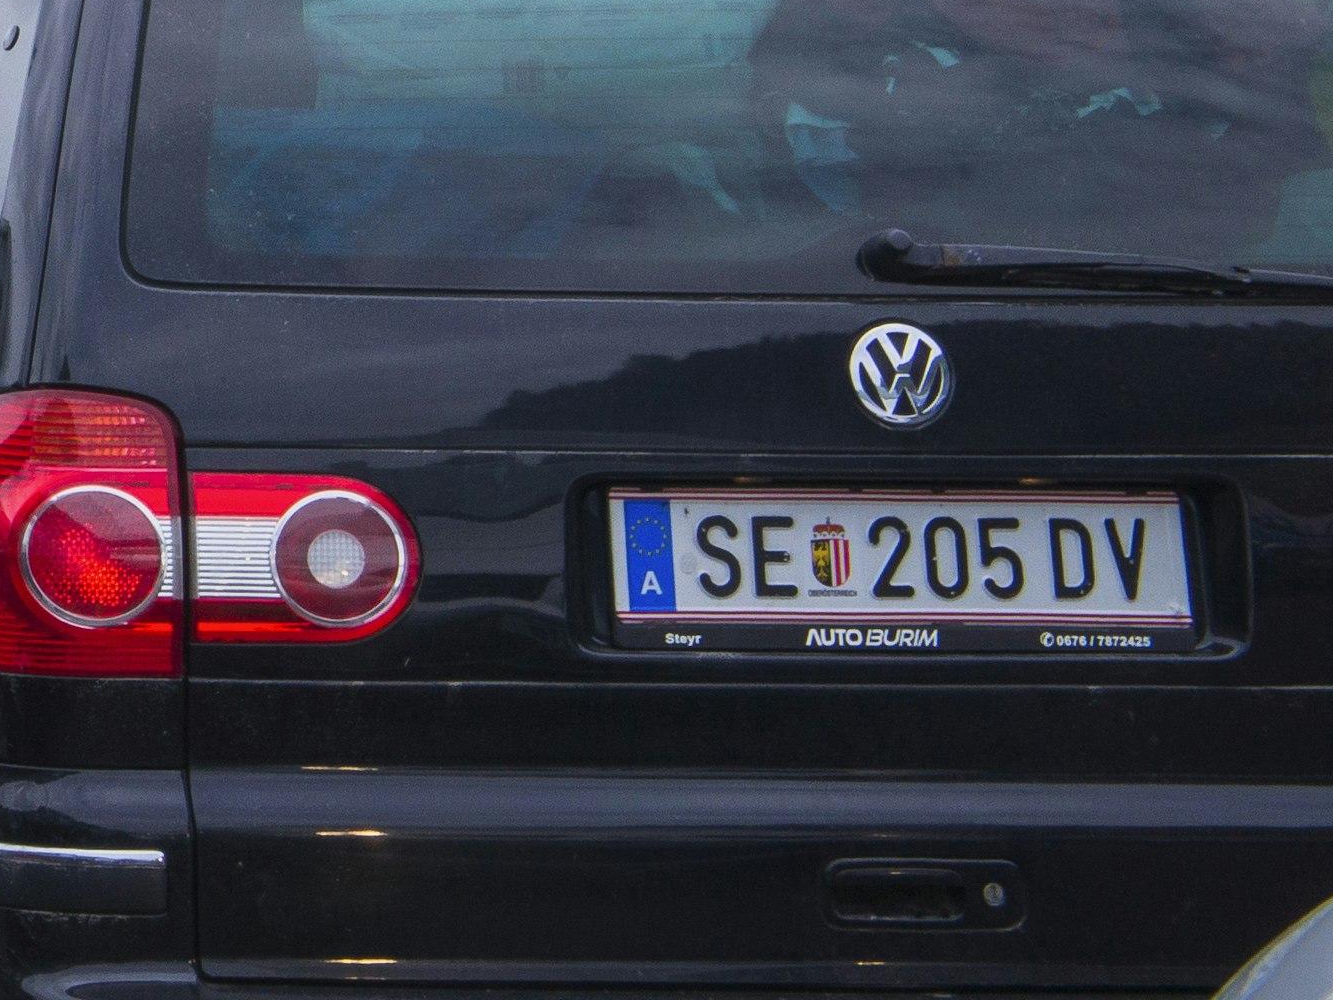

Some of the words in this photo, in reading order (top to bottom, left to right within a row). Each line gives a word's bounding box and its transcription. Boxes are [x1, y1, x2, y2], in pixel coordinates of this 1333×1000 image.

[697, 515, 798, 598] SE
[868, 516, 1024, 599] 205
[1049, 518, 1145, 600] DV
[640, 571, 662, 595] A
[665, 633, 702, 645] Steyr
[805, 629, 863, 646] AUTO
[865, 629, 939, 647] BURIM
[1056, 635, 1087, 646] 0676
[1097, 636, 1151, 647] 7872425
